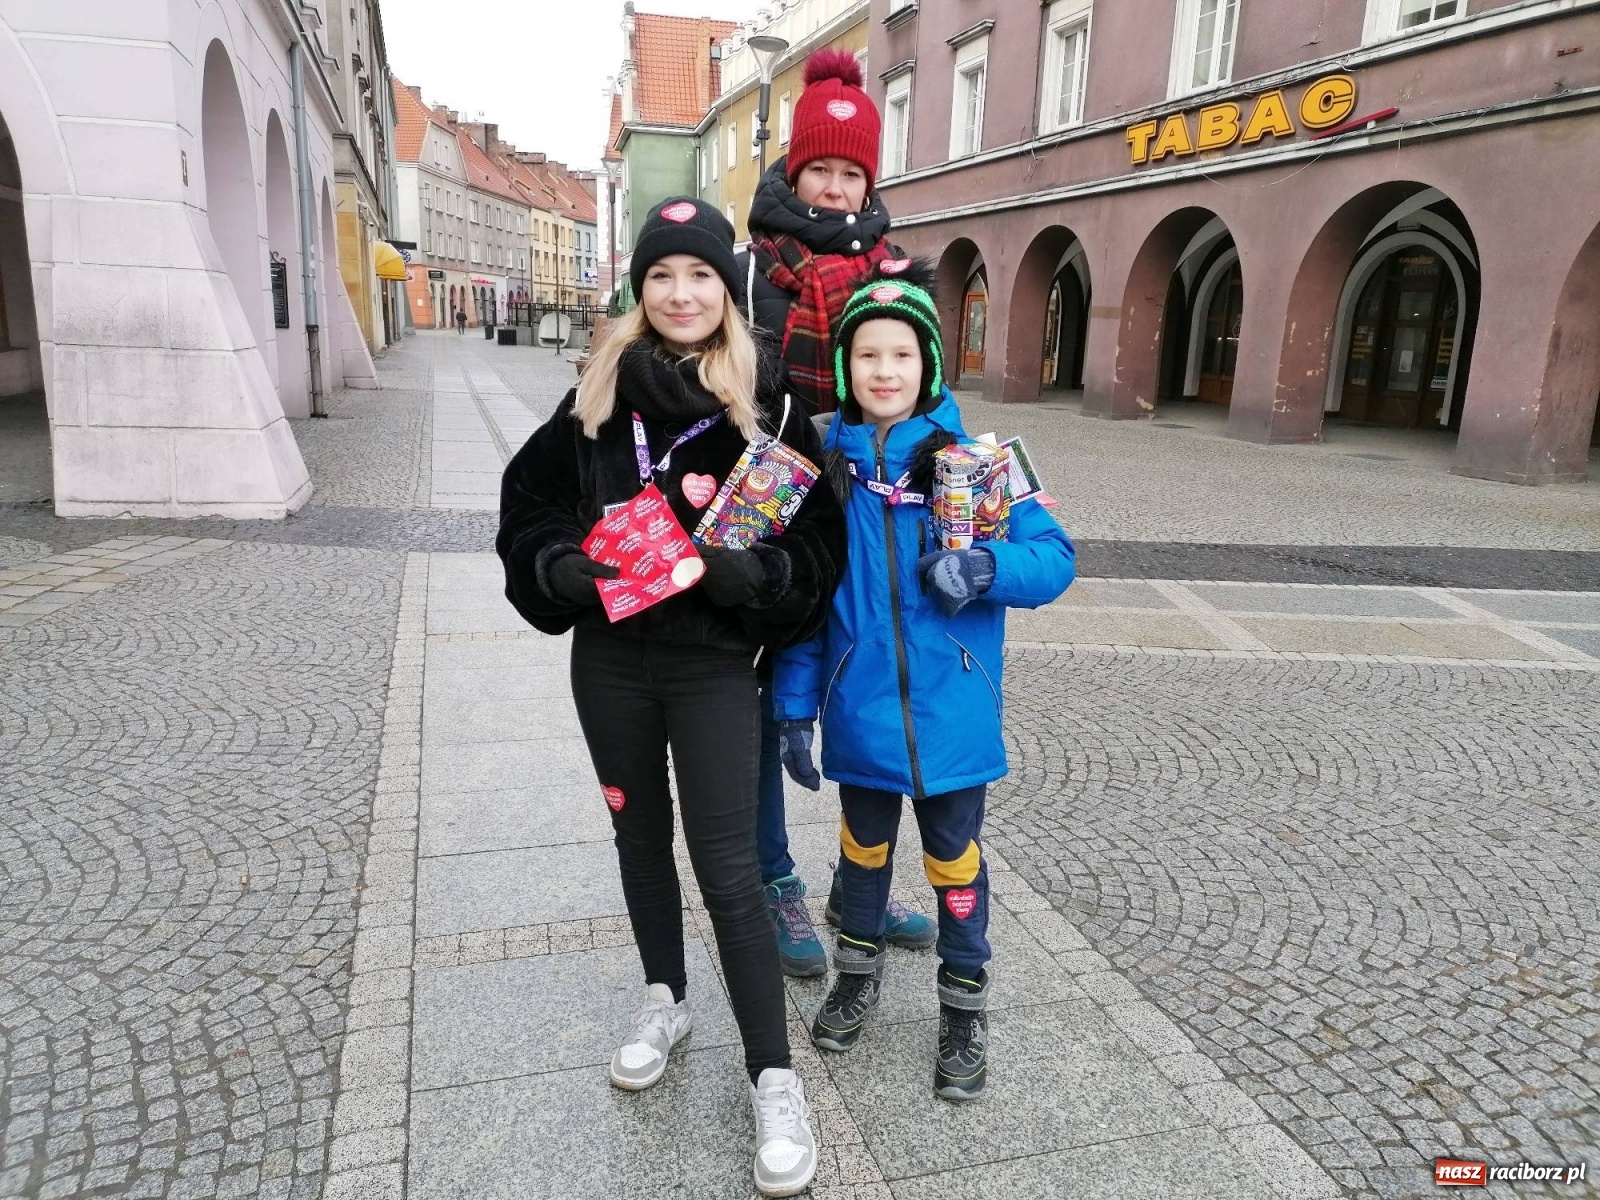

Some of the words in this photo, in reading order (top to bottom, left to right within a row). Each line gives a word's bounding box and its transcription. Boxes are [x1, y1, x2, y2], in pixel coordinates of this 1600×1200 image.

[1126, 74, 1356, 165] TABAC
[635, 422, 643, 443] PLAY
[902, 494, 922, 502] PLAY
